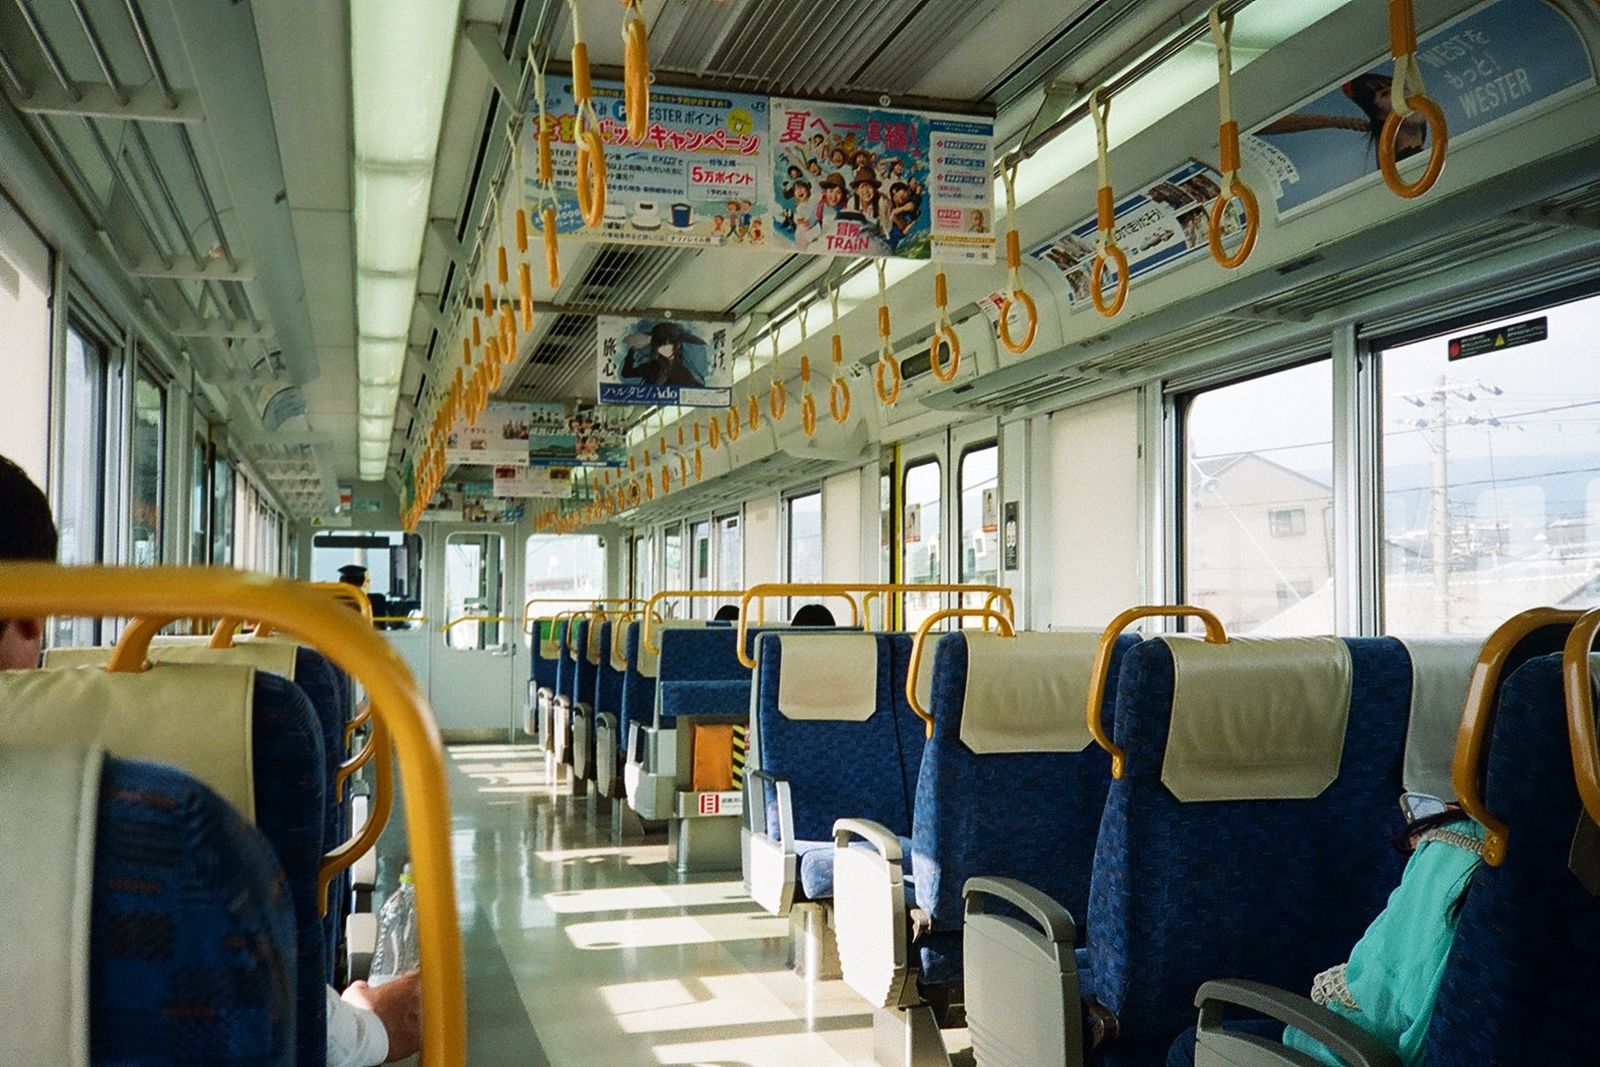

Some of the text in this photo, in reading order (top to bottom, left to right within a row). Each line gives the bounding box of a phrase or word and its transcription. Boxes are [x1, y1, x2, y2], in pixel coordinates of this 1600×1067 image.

[1459, 68, 1532, 119] WESTER
[779, 110, 922, 158] 夏へ一直線!
[691, 165, 754, 185] 5万ポイント
